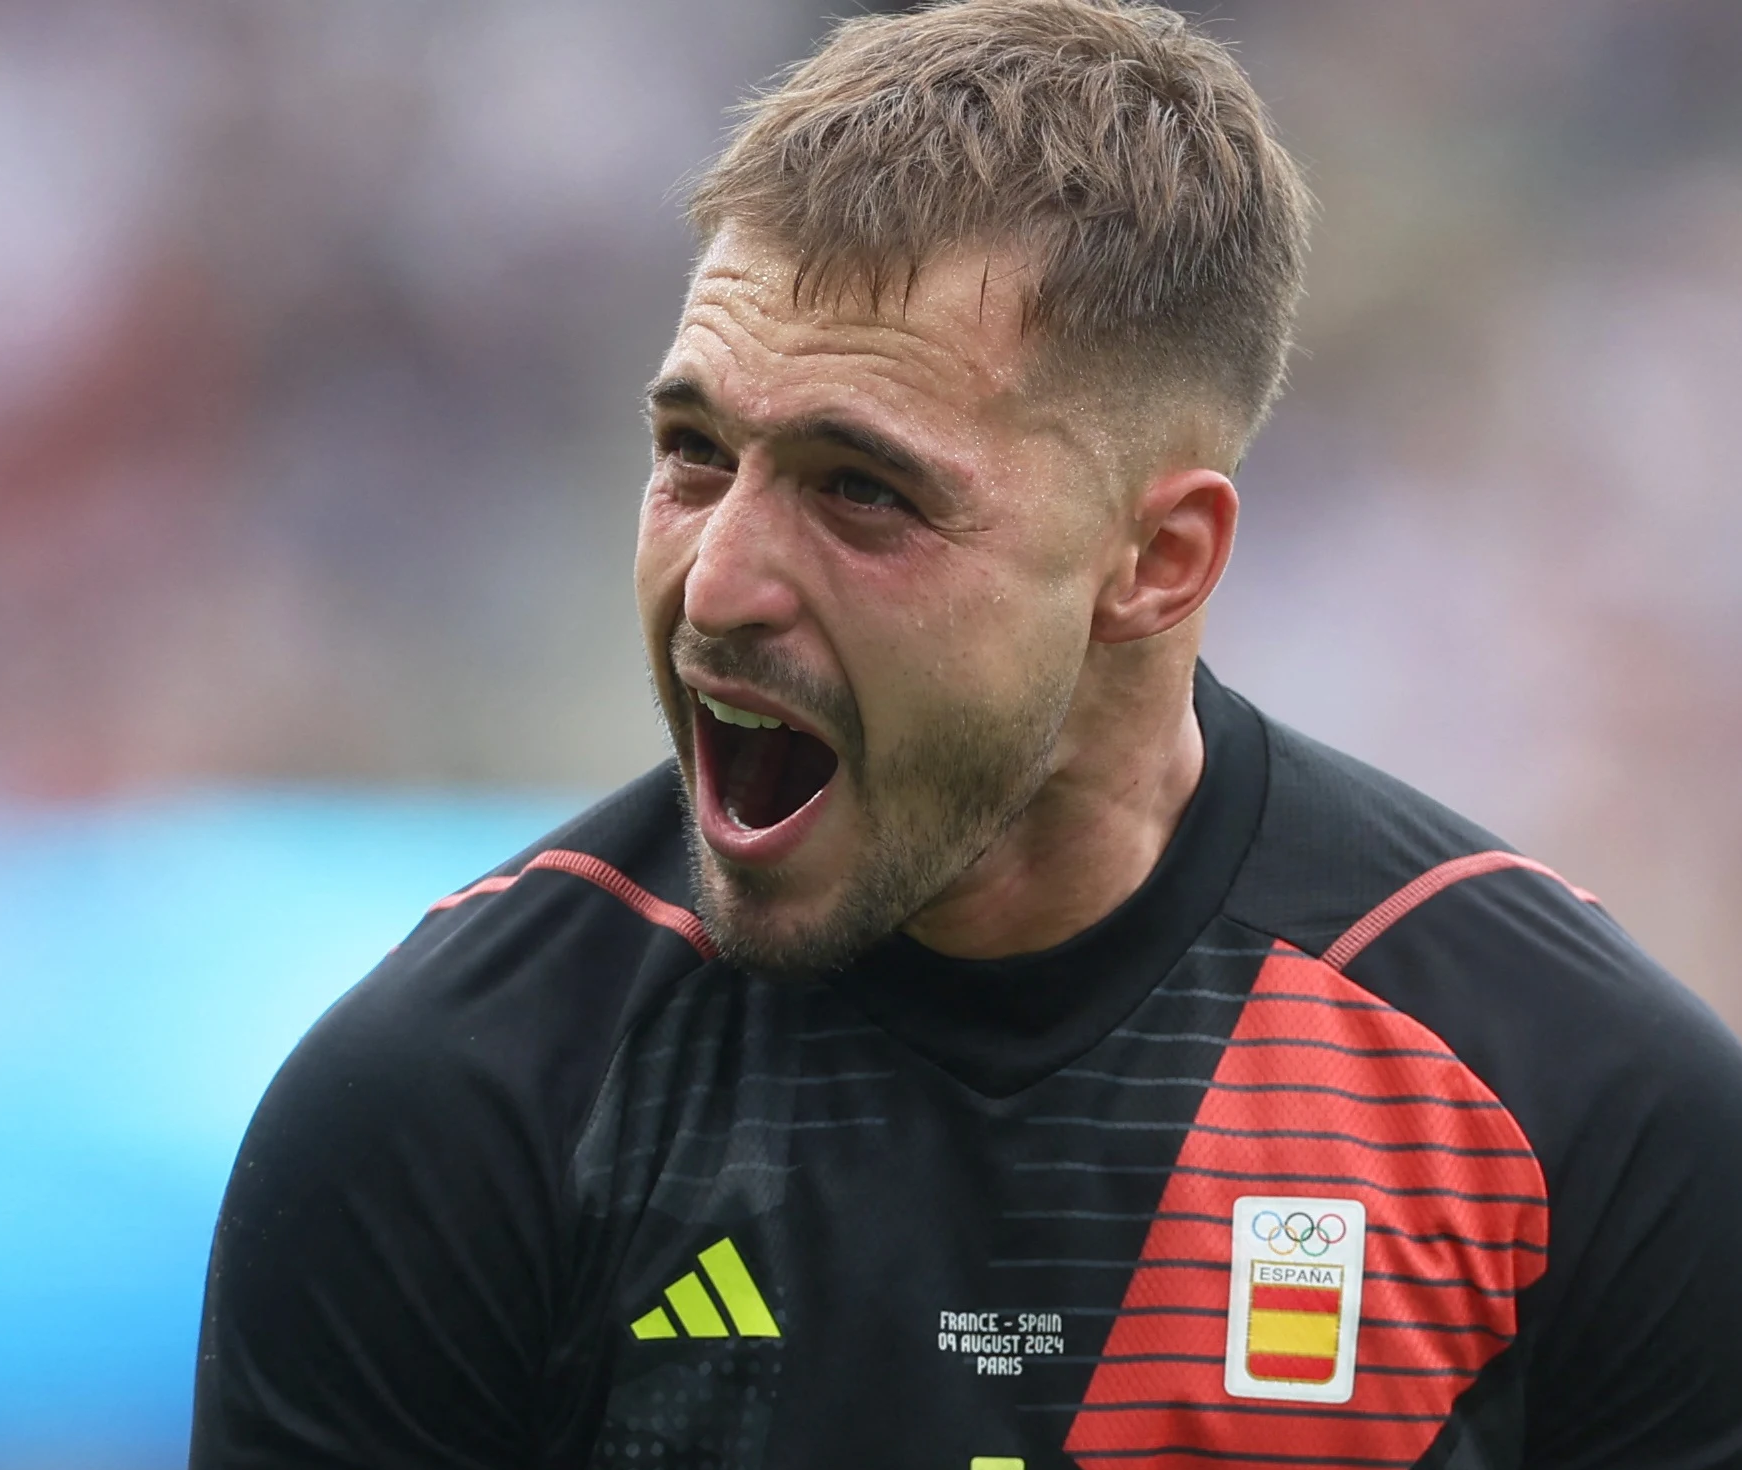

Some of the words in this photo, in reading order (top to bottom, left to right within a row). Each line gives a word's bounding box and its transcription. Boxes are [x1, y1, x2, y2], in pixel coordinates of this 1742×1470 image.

[1260, 1267, 1333, 1284] ESPAÑA
[940, 1311, 998, 1332] FRANCE
[1018, 1313, 1062, 1332] SPAIN
[961, 1334, 1020, 1353] AUGUST
[1025, 1335, 1064, 1354] 2024
[977, 1356, 1022, 1375] PARIS
